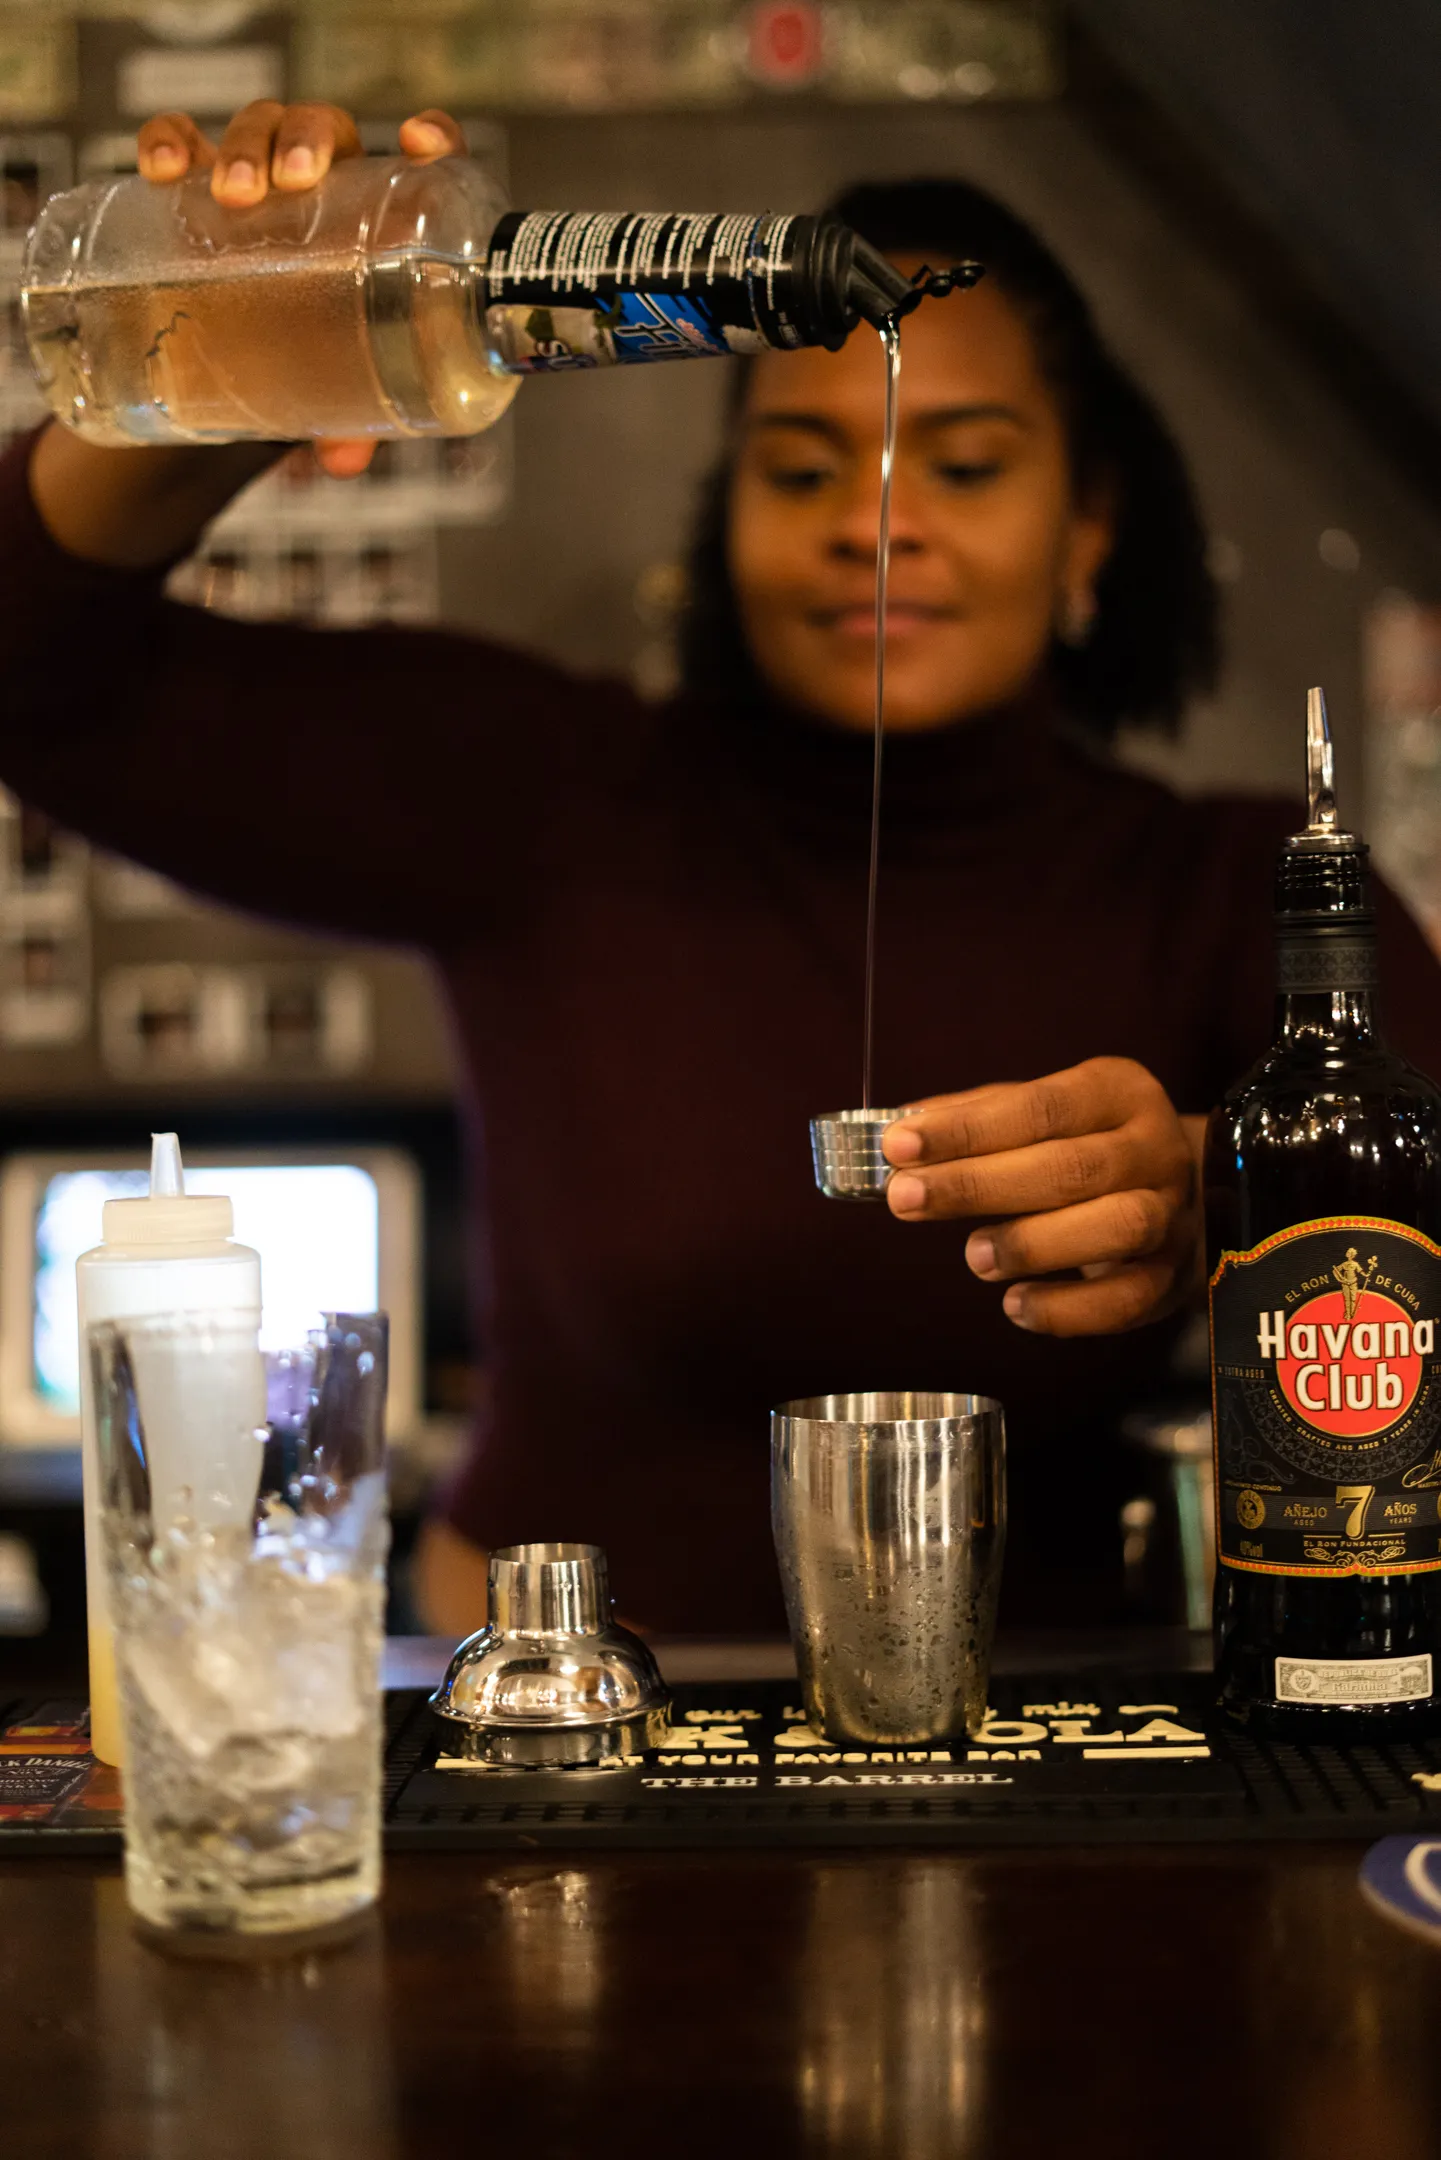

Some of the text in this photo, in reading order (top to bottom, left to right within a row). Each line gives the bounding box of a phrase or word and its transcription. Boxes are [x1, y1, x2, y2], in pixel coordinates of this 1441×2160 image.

[1285, 1274, 1421, 1311] EL RON DE CUBA
[1257, 1310, 1434, 1360] Havana
[1295, 1362, 1404, 1411] Club
[1390, 1419, 1413, 1439] YEARS
[1283, 1503, 1328, 1518] AÑEJO
[1336, 1485, 1376, 1540] 7
[1383, 1501, 1417, 1517] AÑOS
[1340, 1539, 1406, 1547] FUNDACIONAL
[968, 1718, 1206, 1744] OLA
[658, 1753, 760, 1766] YOUR
[774, 1751, 952, 1765] FAVORITE
[967, 1749, 1042, 1761] BAR
[641, 1774, 1014, 1788] THE BARREL
